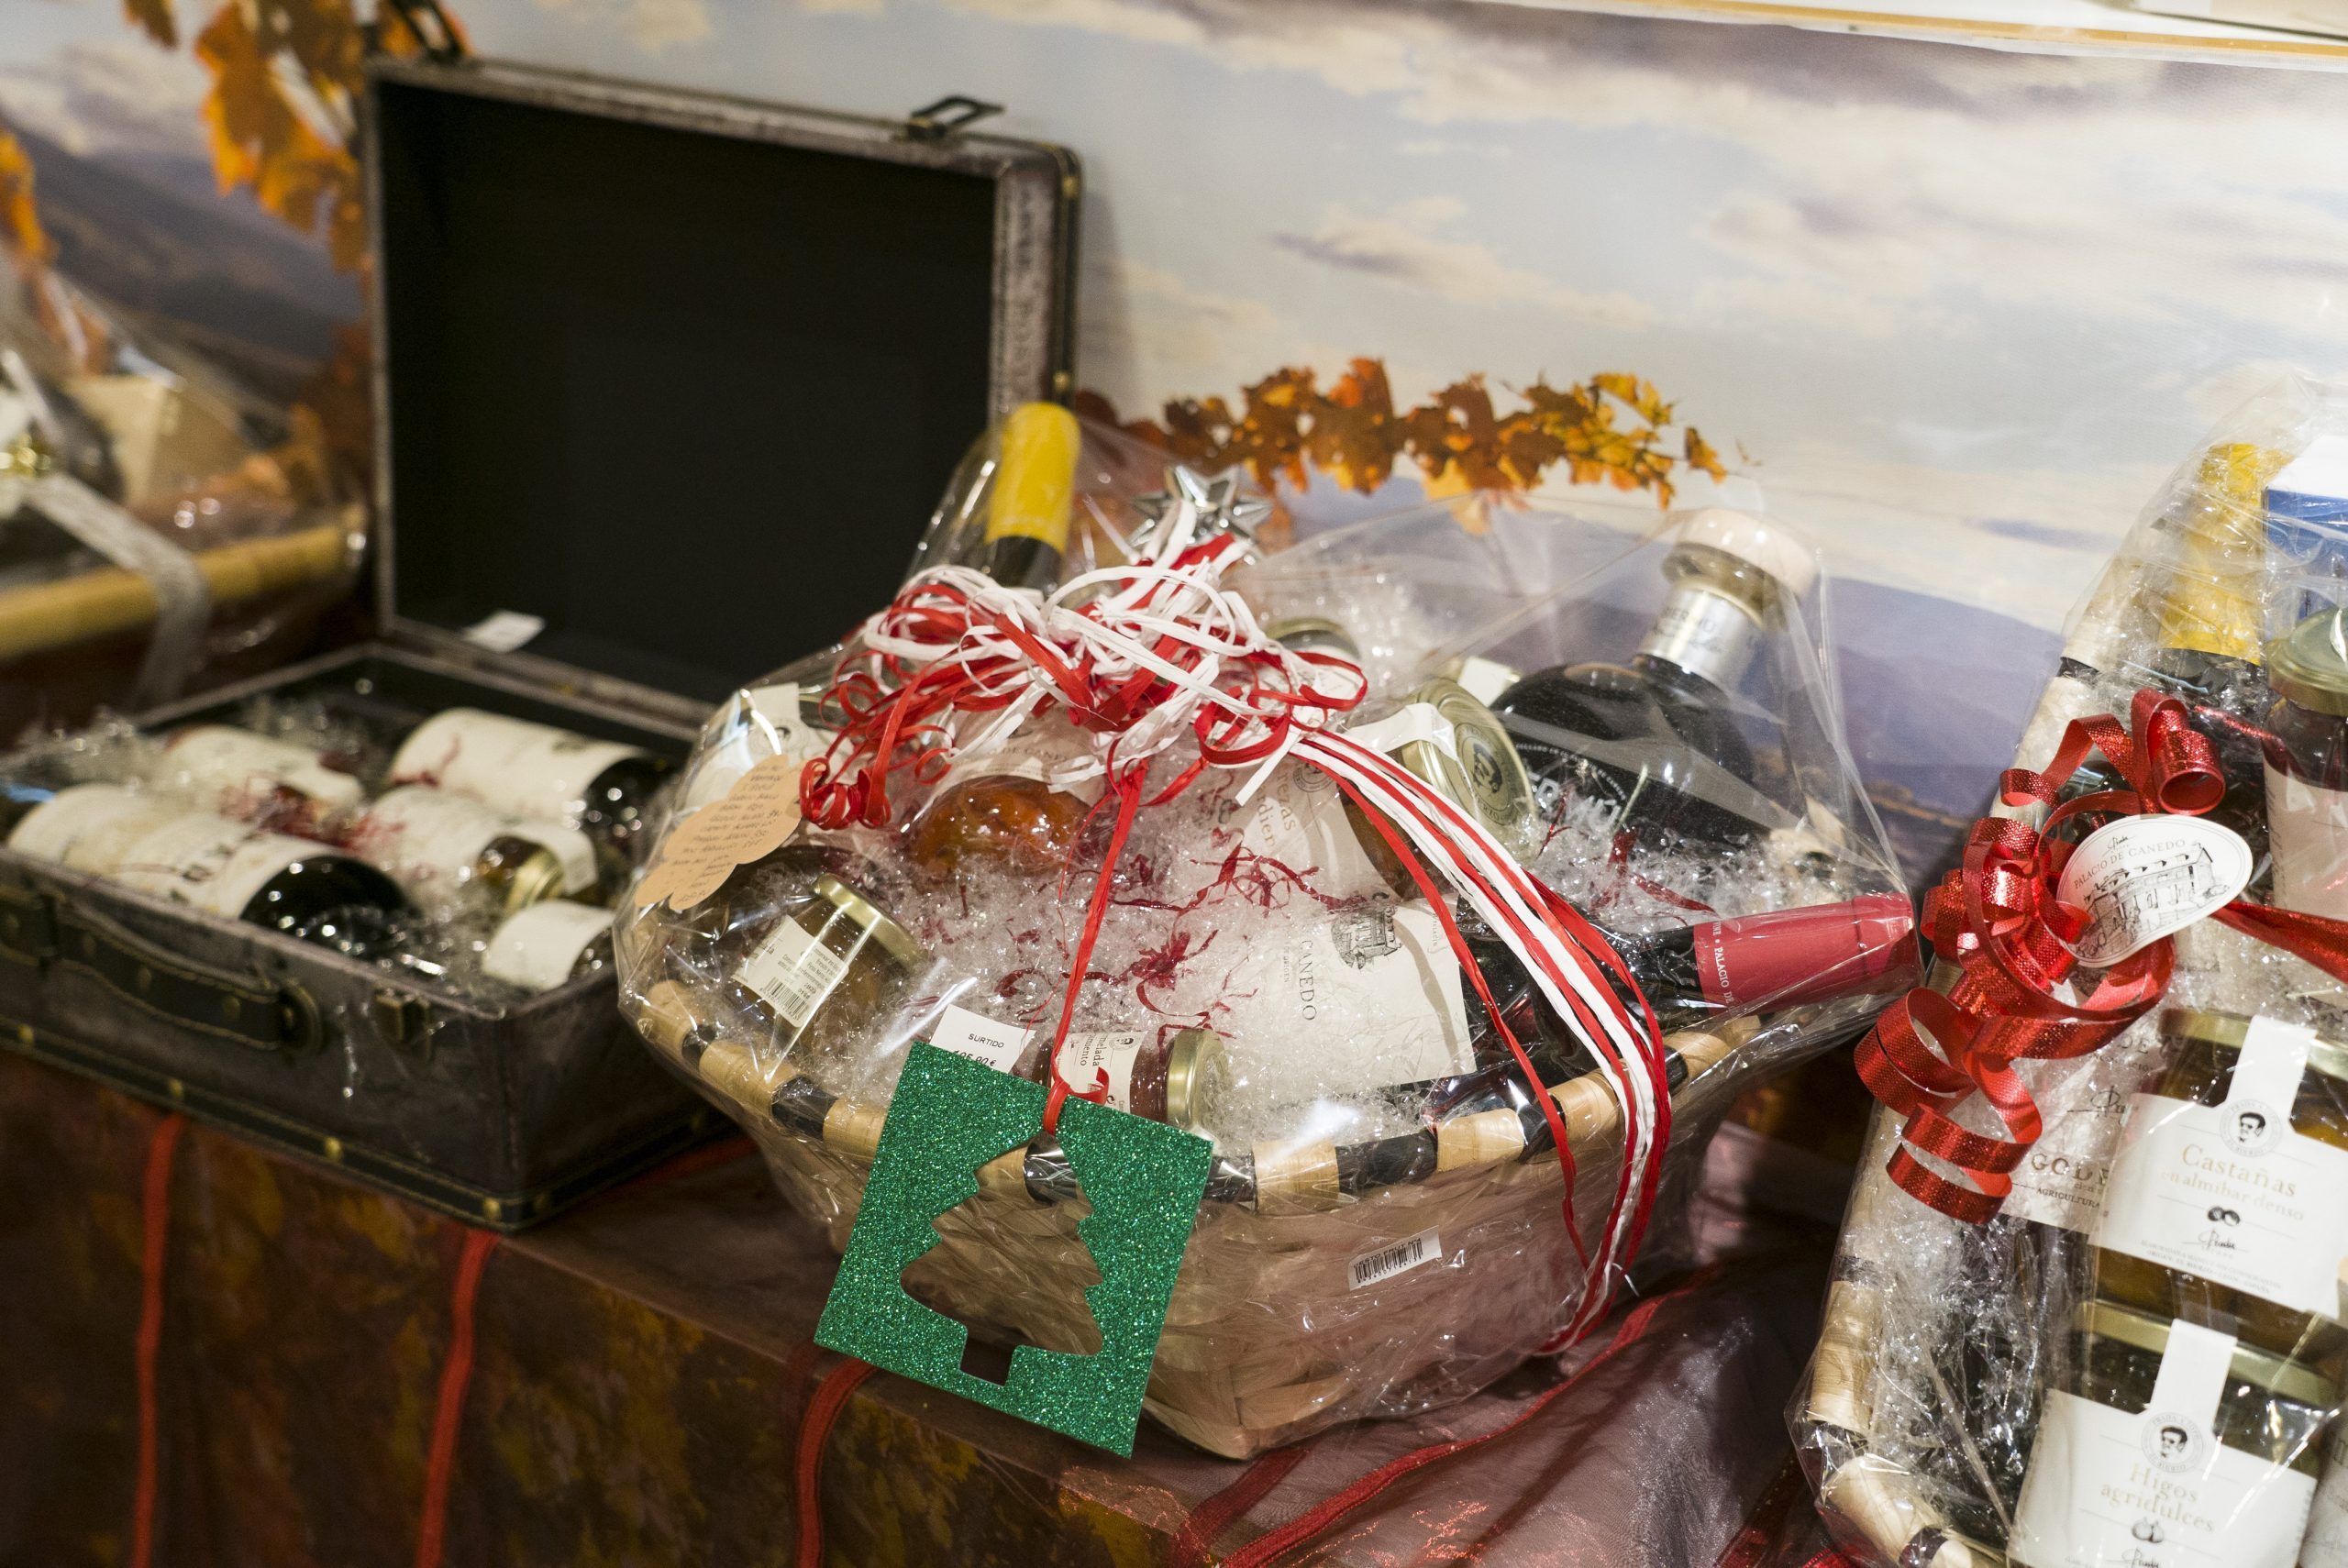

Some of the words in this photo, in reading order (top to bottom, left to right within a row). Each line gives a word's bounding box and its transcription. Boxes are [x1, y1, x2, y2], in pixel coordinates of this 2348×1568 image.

[2073, 858, 2109, 890] PALACIO
[2110, 852, 2124, 867] DE
[2128, 839, 2187, 856] CANEDO
[1298, 939, 1318, 1021] CANEDO
[1714, 947, 1730, 988] PALACIO
[1724, 991, 1734, 1004] DE
[968, 1033, 1004, 1048] SURTIDO
[2160, 1169, 2180, 1184] en
[2252, 1192, 2305, 1222] denso
[2182, 1143, 2297, 1198] Castañas
[2036, 1187, 2100, 1209] AGRICULTURA
[2131, 1462, 2198, 1503] Higos
[2100, 1483, 2214, 1534] agridulces
